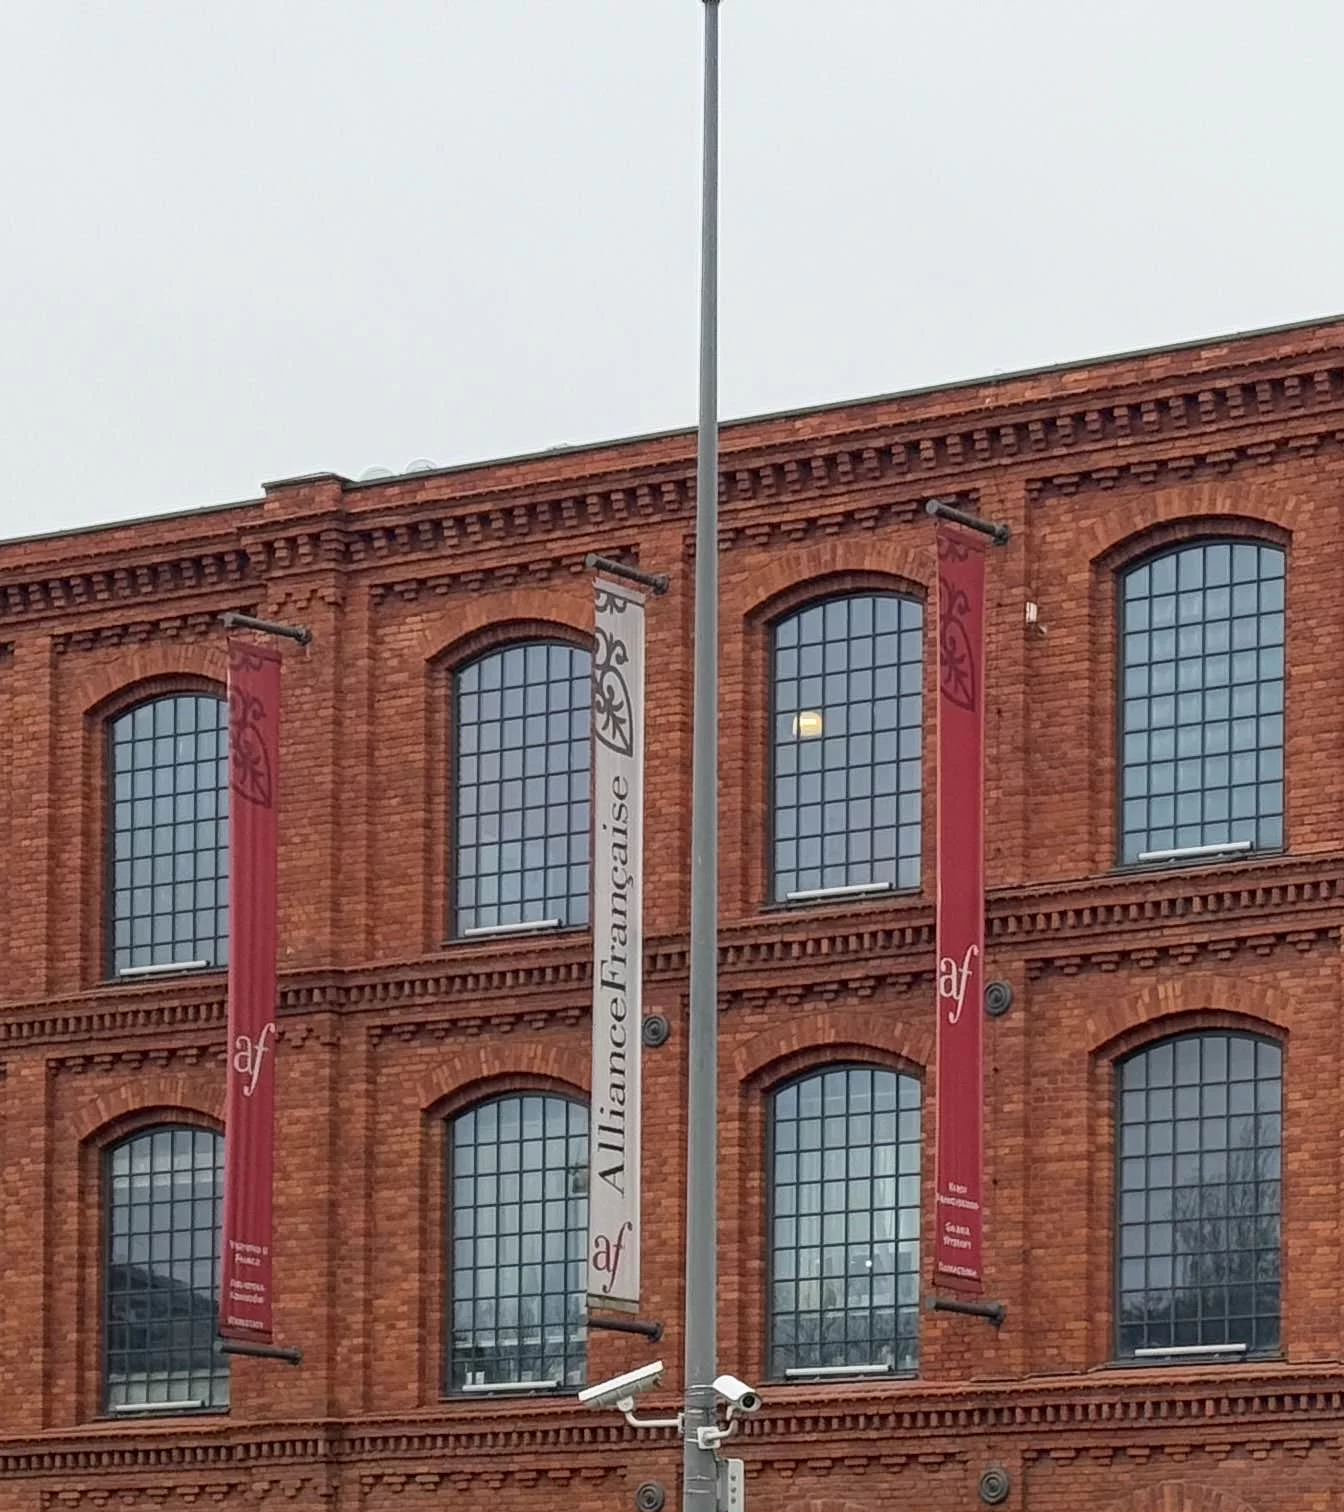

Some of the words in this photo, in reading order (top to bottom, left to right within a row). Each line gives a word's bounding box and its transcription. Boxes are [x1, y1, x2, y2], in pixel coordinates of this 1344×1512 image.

[939, 944, 979, 1024] af
[233, 1023, 275, 1096] af
[593, 1222, 632, 1292] af
